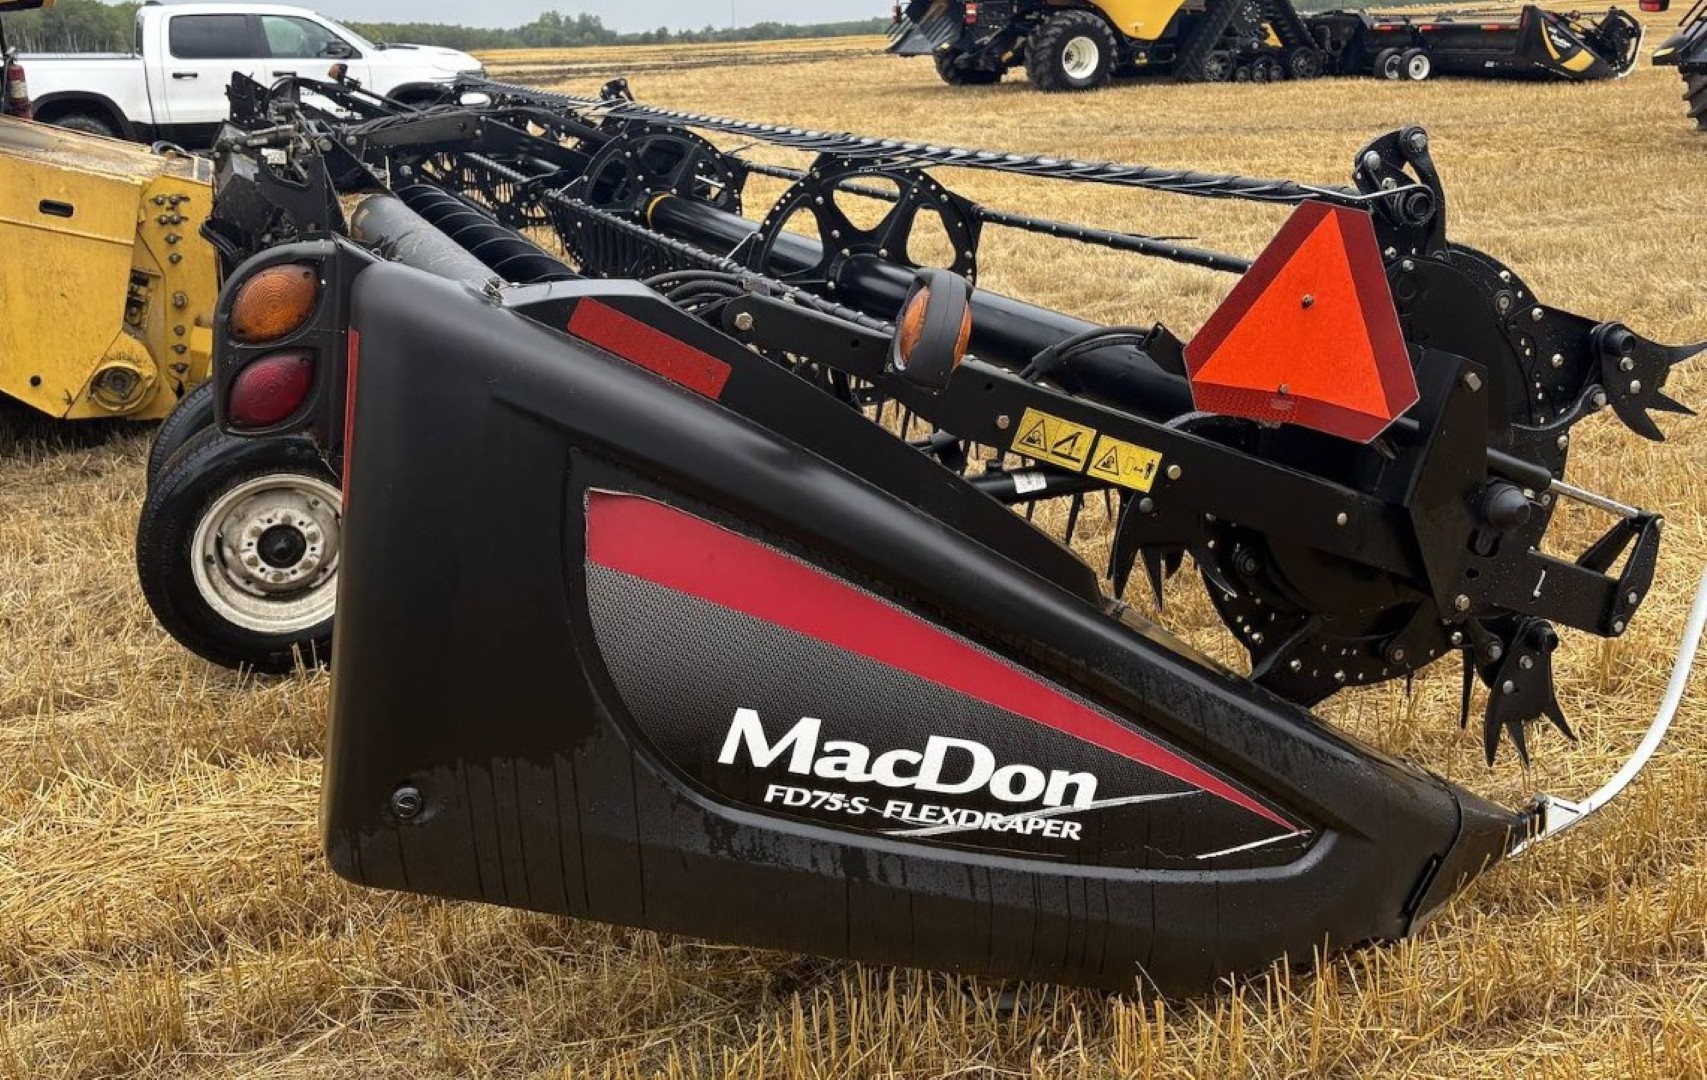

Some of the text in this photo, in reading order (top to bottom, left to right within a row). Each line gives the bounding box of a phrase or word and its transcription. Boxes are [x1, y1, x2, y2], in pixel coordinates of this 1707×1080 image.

[717, 707, 1098, 809] MacDon
[764, 784, 1082, 840] FD75-S FLEXDRAPER
